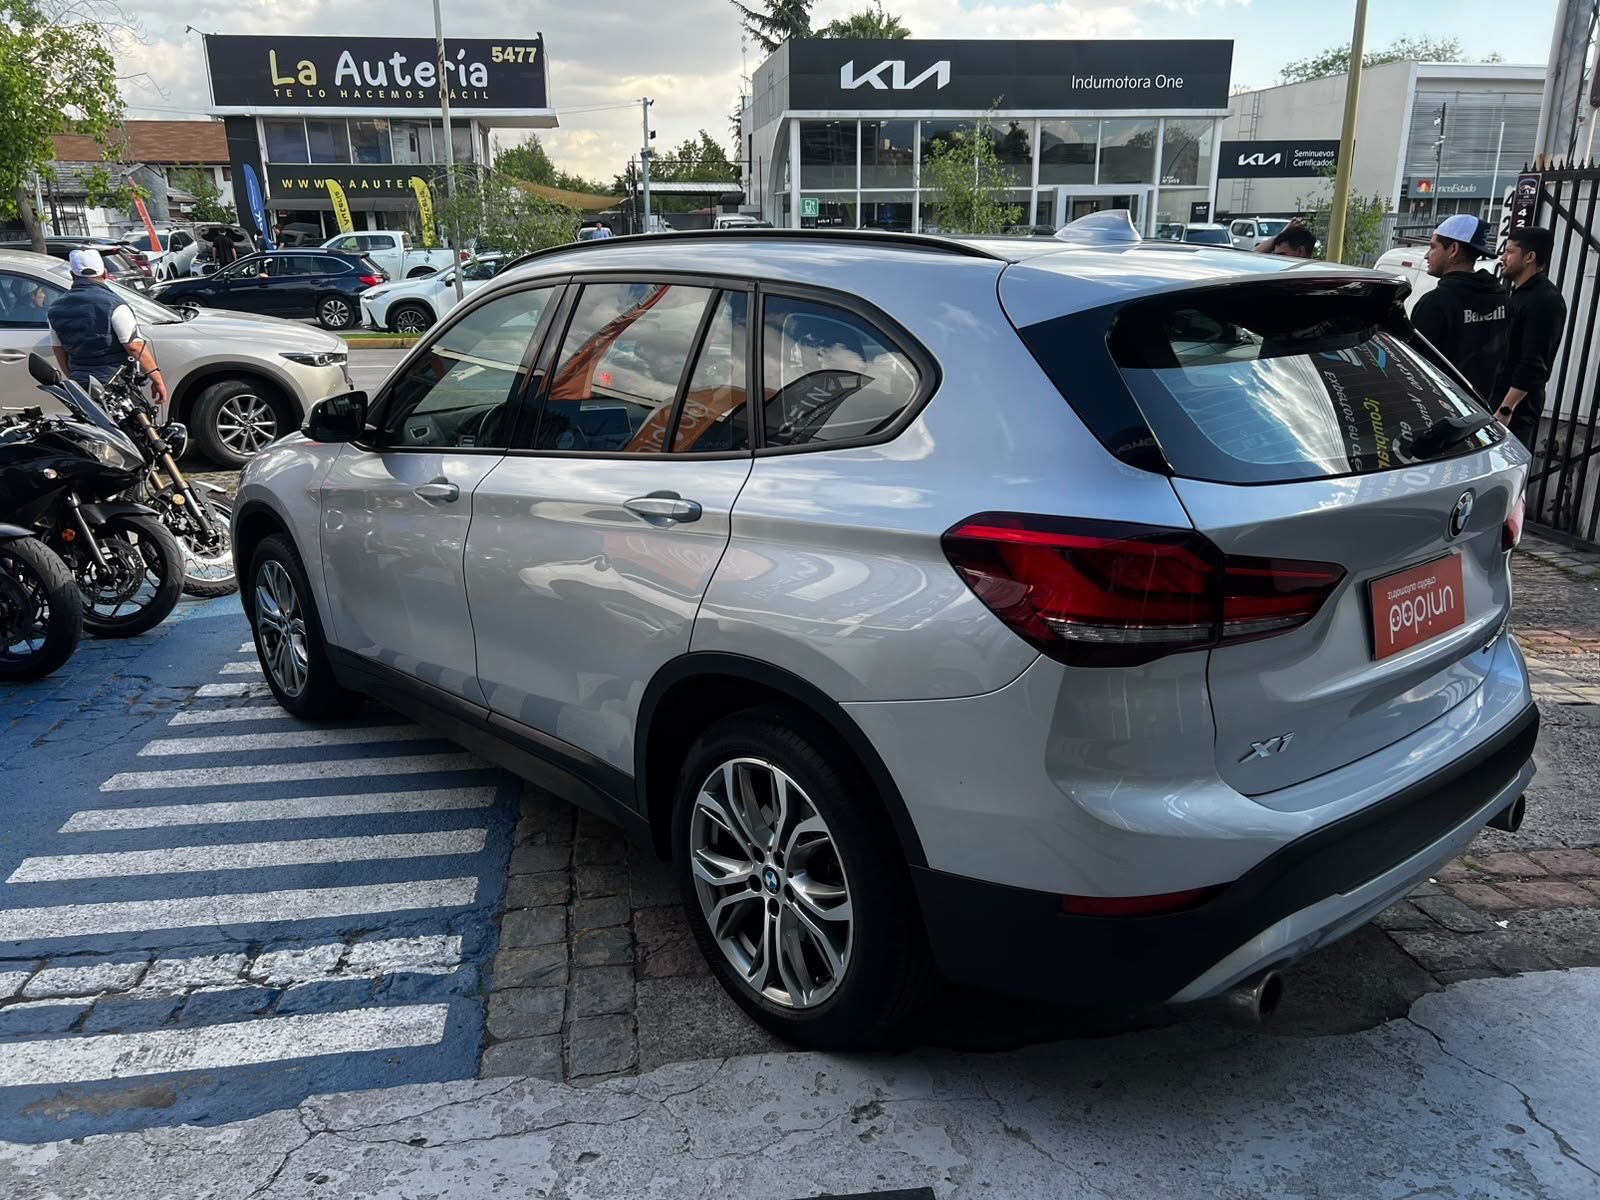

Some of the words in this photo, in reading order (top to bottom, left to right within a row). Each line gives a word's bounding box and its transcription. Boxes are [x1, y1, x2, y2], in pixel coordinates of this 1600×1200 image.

[491, 46, 537, 63] 5477
[268, 49, 317, 87] La
[840, 60, 951, 90] KIA
[1071, 74, 1151, 90] Indumotora
[1154, 74, 1184, 89] One
[273, 89, 293, 98] TE
[307, 89, 326, 98] LO
[340, 90, 425, 99] HACEMOS
[1237, 152, 1282, 166] KIA
[1294, 149, 1335, 157] Seminuevos
[1292, 158, 1333, 167] Certificados
[1430, 183, 1477, 193] BncoEstado
[1389, 585, 1455, 645] unidad
[1237, 731, 1295, 764] X1
